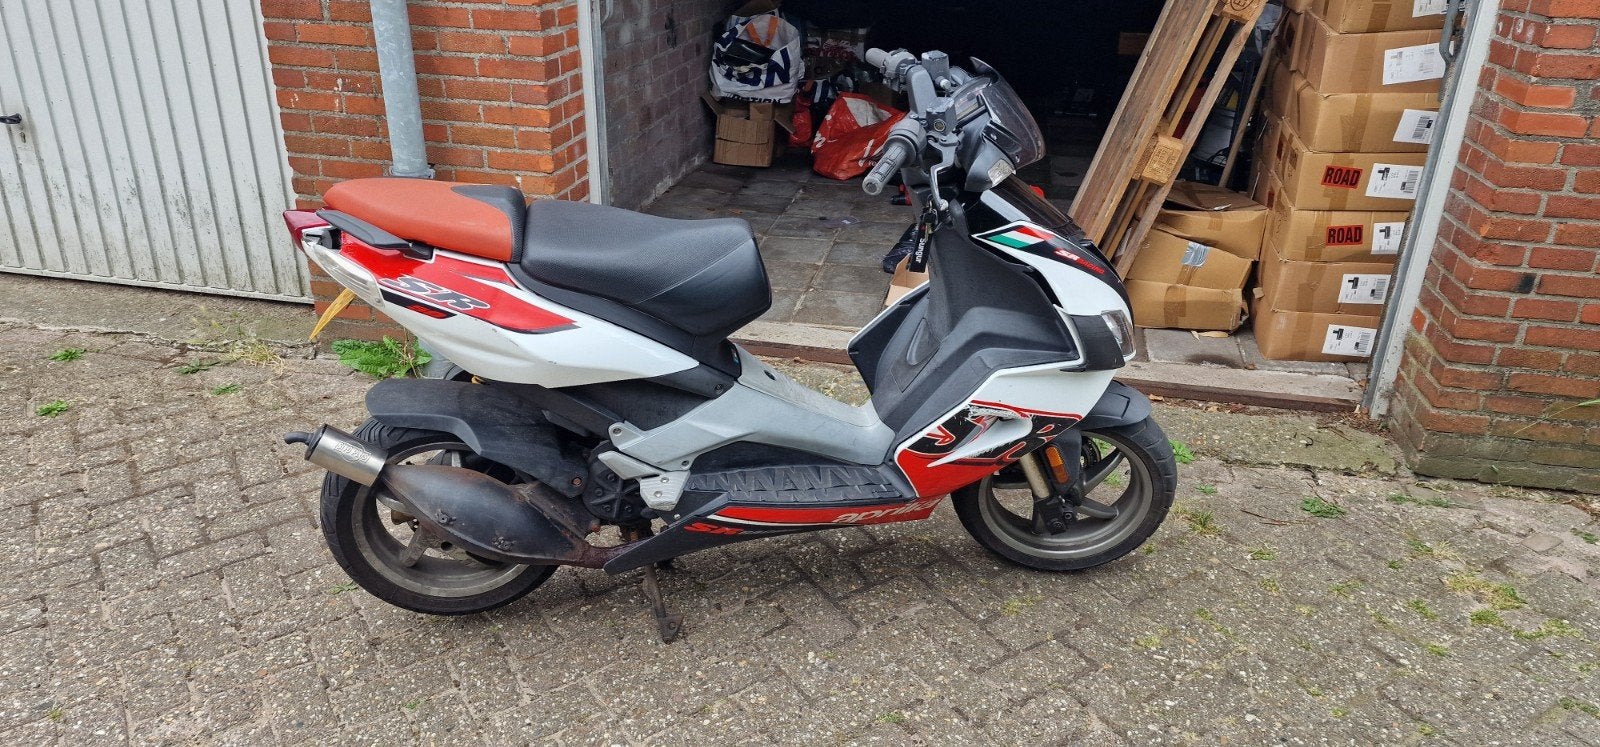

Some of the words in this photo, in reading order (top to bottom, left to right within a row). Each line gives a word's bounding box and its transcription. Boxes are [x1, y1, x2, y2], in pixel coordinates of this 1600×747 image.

[1323, 167, 1361, 187] ROAD
[1327, 226, 1363, 244] ROAD
[378, 274, 490, 310] SR
